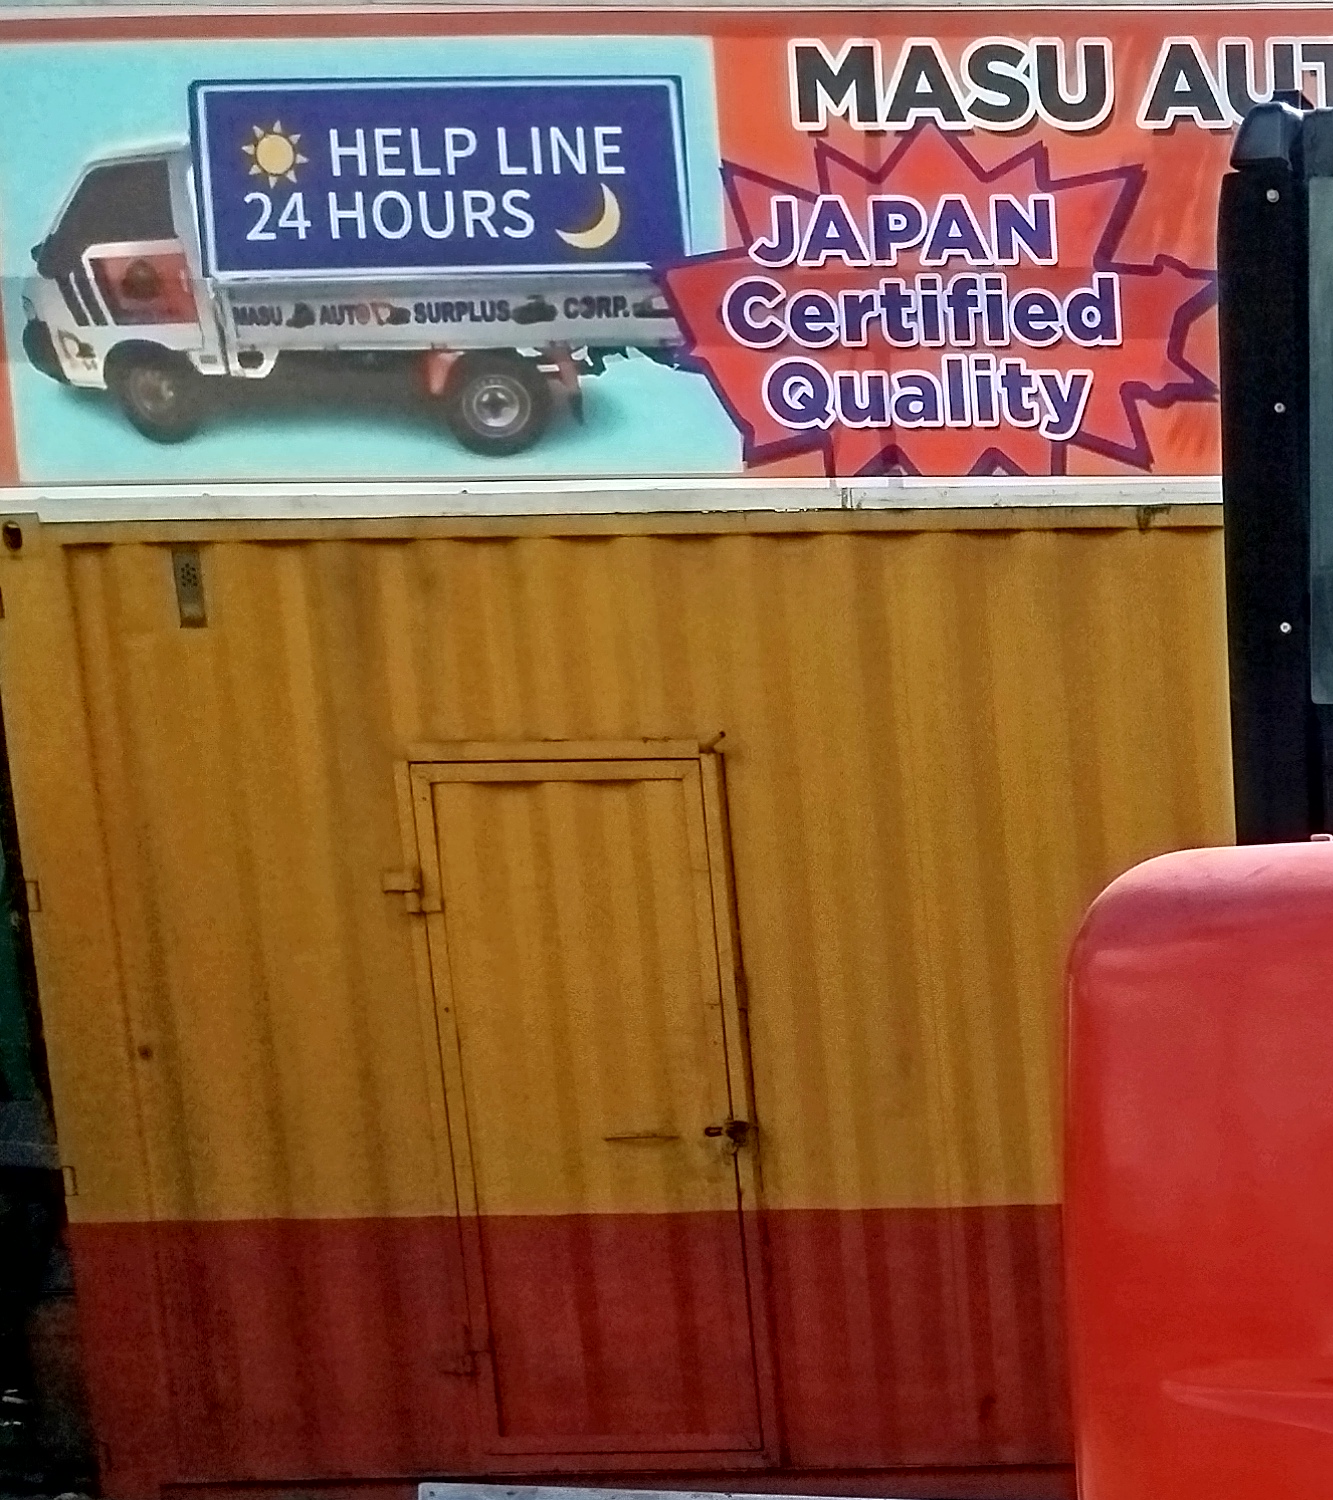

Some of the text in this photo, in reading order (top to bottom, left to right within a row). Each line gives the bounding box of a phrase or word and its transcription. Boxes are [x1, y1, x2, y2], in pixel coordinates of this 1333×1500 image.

[790, 37, 1112, 130] MASU
[330, 126, 626, 177] HELP LINE
[244, 189, 535, 242] 24 HOURS
[749, 195, 1059, 267] JAPAN
[231, 304, 284, 327] MASU
[413, 299, 512, 324] SURPLUS
[722, 272, 1122, 348] Certified
[764, 354, 1094, 441] Quality
